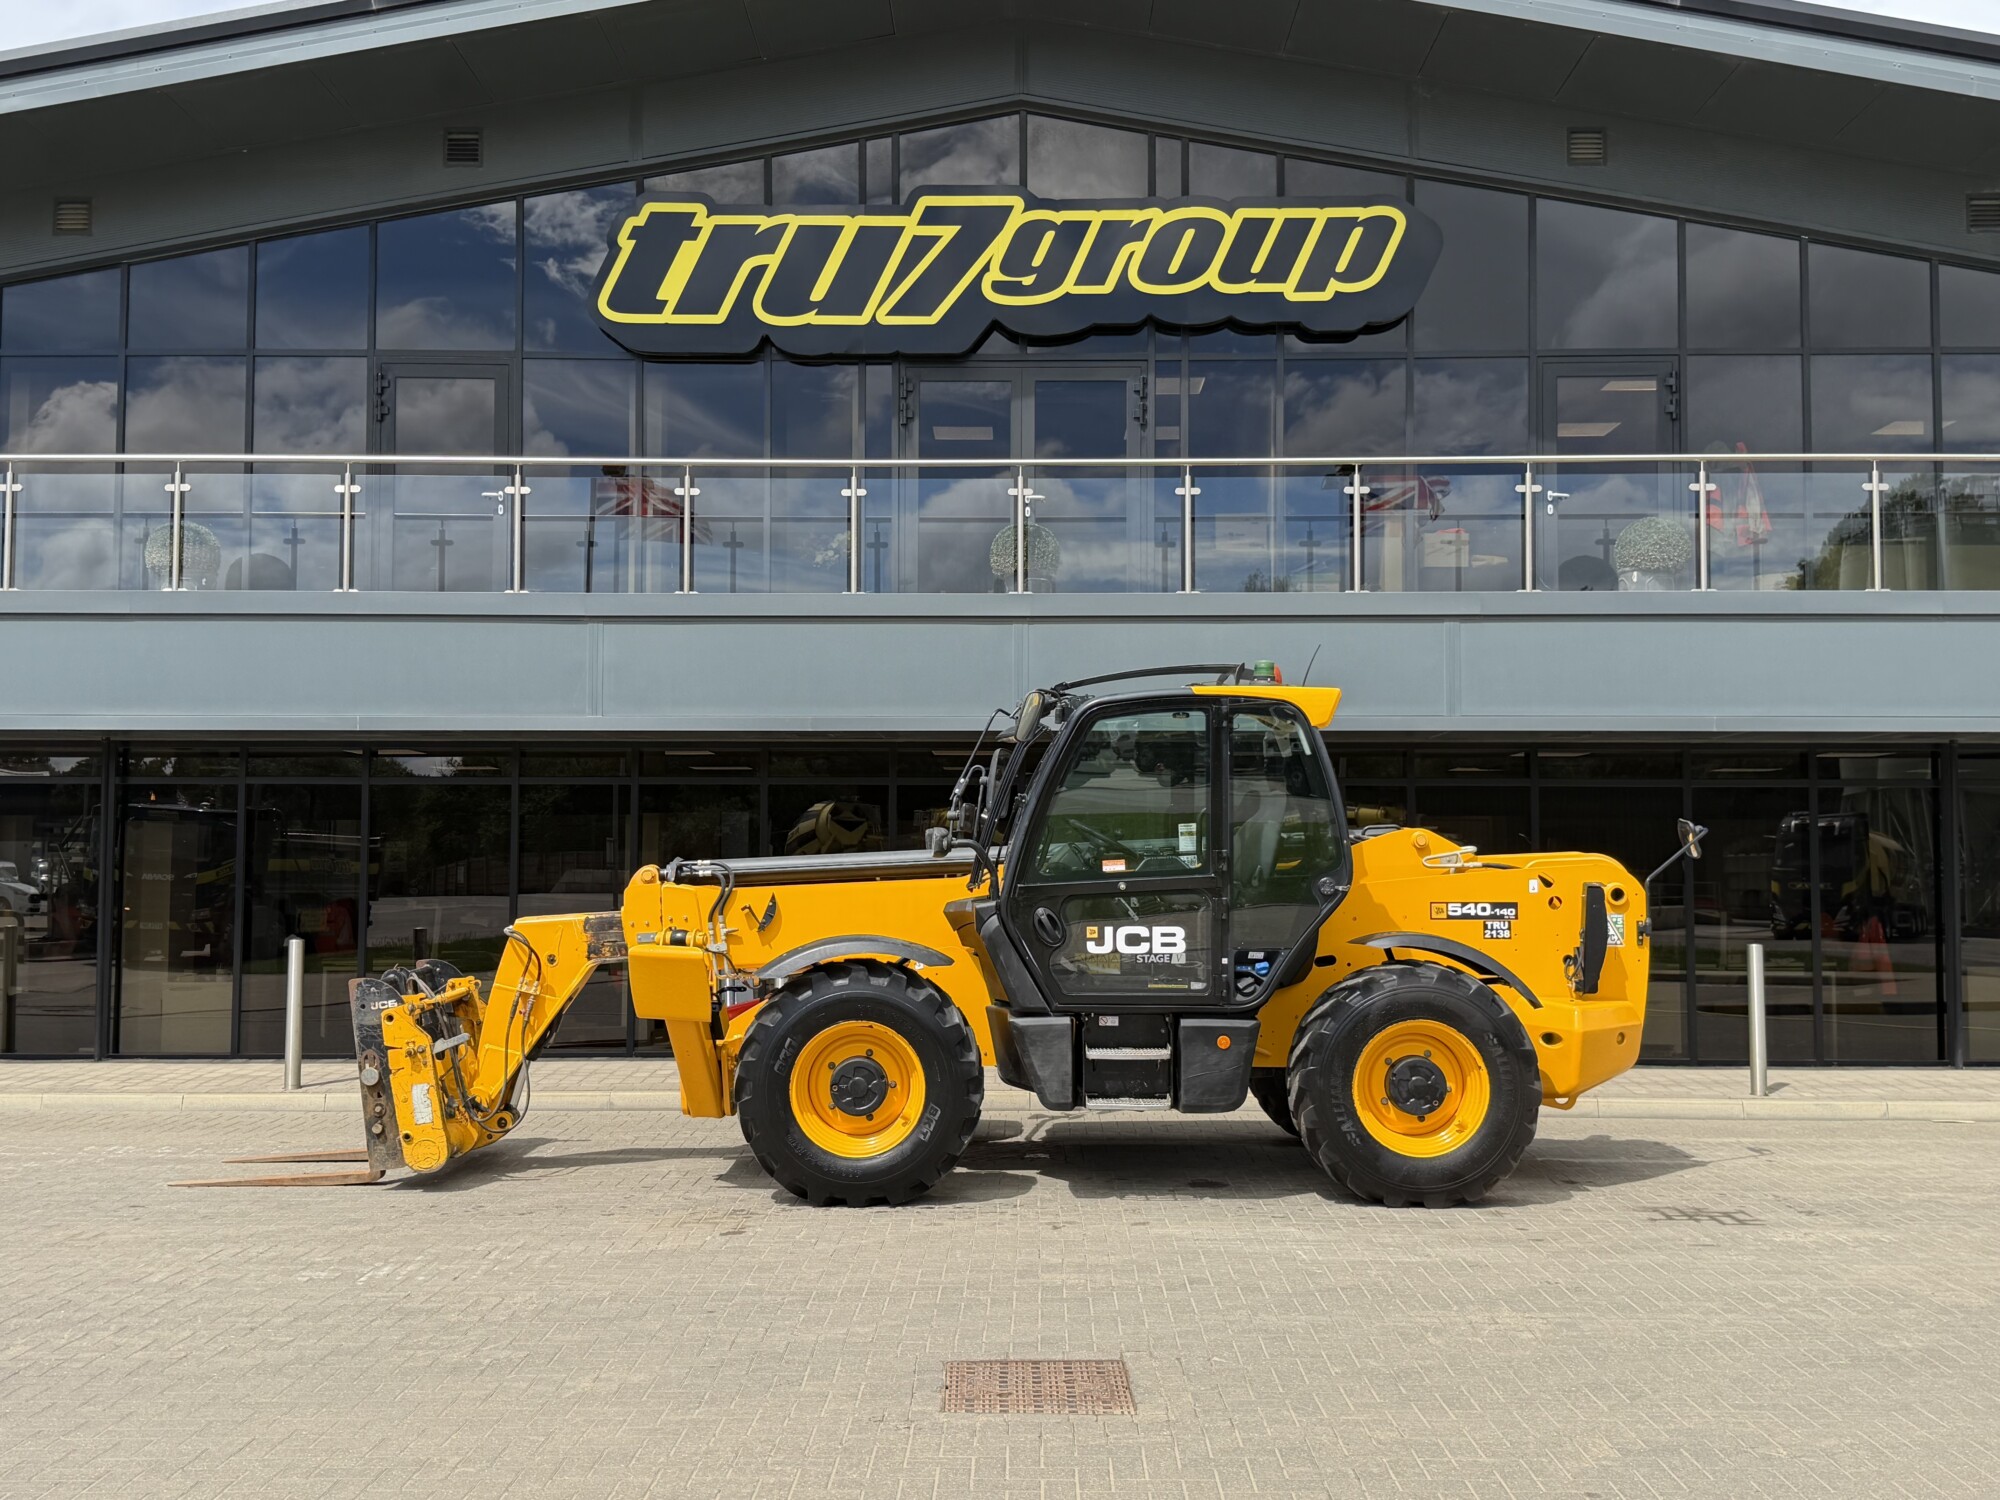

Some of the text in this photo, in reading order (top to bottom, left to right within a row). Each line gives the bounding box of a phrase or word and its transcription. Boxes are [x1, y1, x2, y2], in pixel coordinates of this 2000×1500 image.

[1447, 903, 1516, 916] 540-140
[1485, 921, 1509, 929] TRU
[1484, 930, 1511, 938] 2138
[1086, 926, 1187, 954] JCB
[1136, 954, 1172, 963] STAGE
[370, 1000, 398, 1010] JCB
